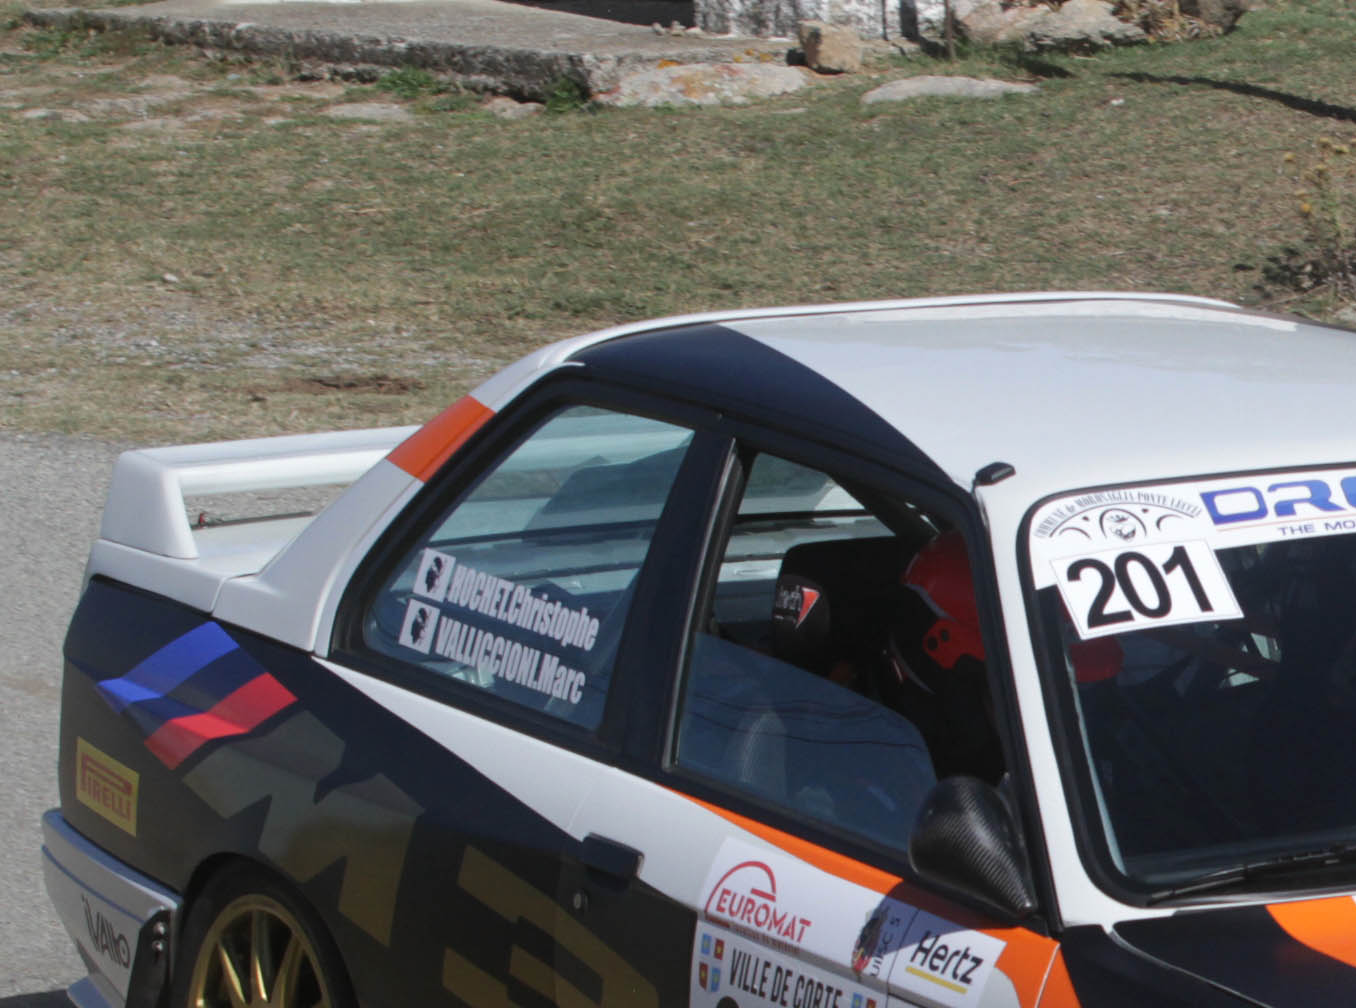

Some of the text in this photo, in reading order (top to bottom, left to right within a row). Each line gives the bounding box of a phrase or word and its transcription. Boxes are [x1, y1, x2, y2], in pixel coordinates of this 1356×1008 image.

[1137, 491, 1167, 506] PONTE
[1278, 523, 1316, 537] THE
[1066, 544, 1214, 630] 201
[80, 752, 132, 822] PIRELLI
[716, 888, 812, 943] EUROMAT
[730, 947, 772, 998] VILLE
[771, 964, 793, 1007] DE
[910, 930, 984, 984] Hertz
